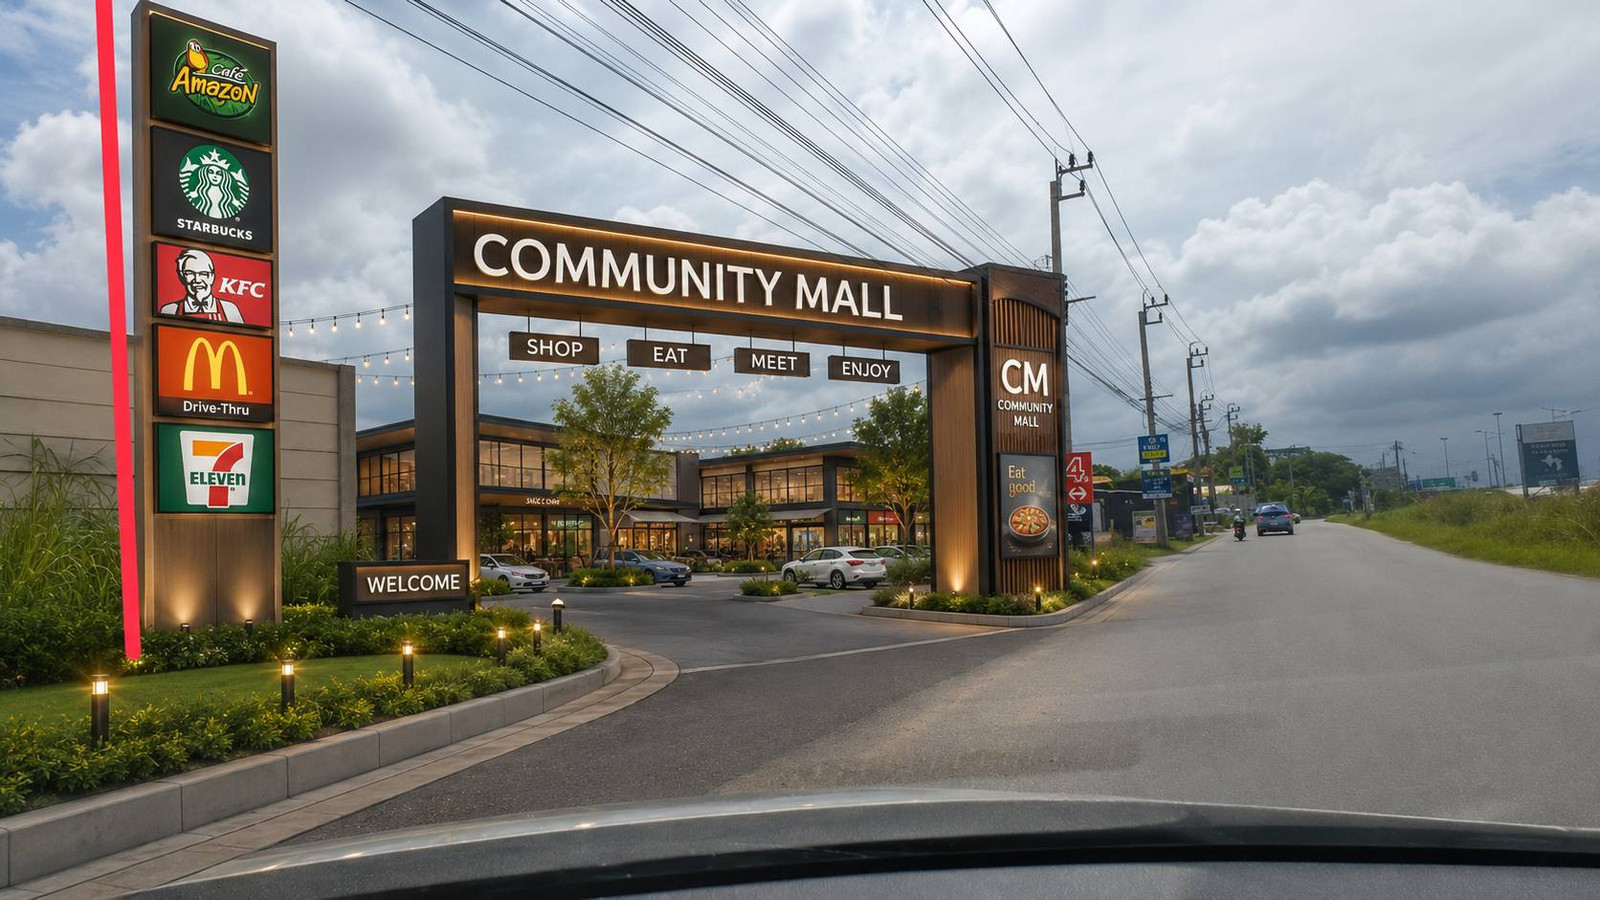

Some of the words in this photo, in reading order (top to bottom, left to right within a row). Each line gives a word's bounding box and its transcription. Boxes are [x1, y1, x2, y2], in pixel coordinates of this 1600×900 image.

[212, 64, 248, 81] Café
[177, 218, 253, 241] STARBUCKS
[474, 233, 782, 306] COMMUNITY
[796, 273, 904, 321] MALL
[219, 277, 266, 298] KFC
[527, 338, 583, 358] SHOP
[653, 346, 688, 363] EAT
[751, 354, 798, 372] MEET
[842, 361, 891, 379] ENJOY
[1001, 358, 1049, 397] CM
[183, 400, 249, 416] Drive-Thru
[997, 399, 1053, 415] COMMUNITY
[1013, 415, 1039, 428] MALL
[192, 440, 244, 507] 7
[1008, 465, 1026, 479] Eat
[1009, 480, 1035, 498] good
[367, 573, 461, 595] WELCOME
